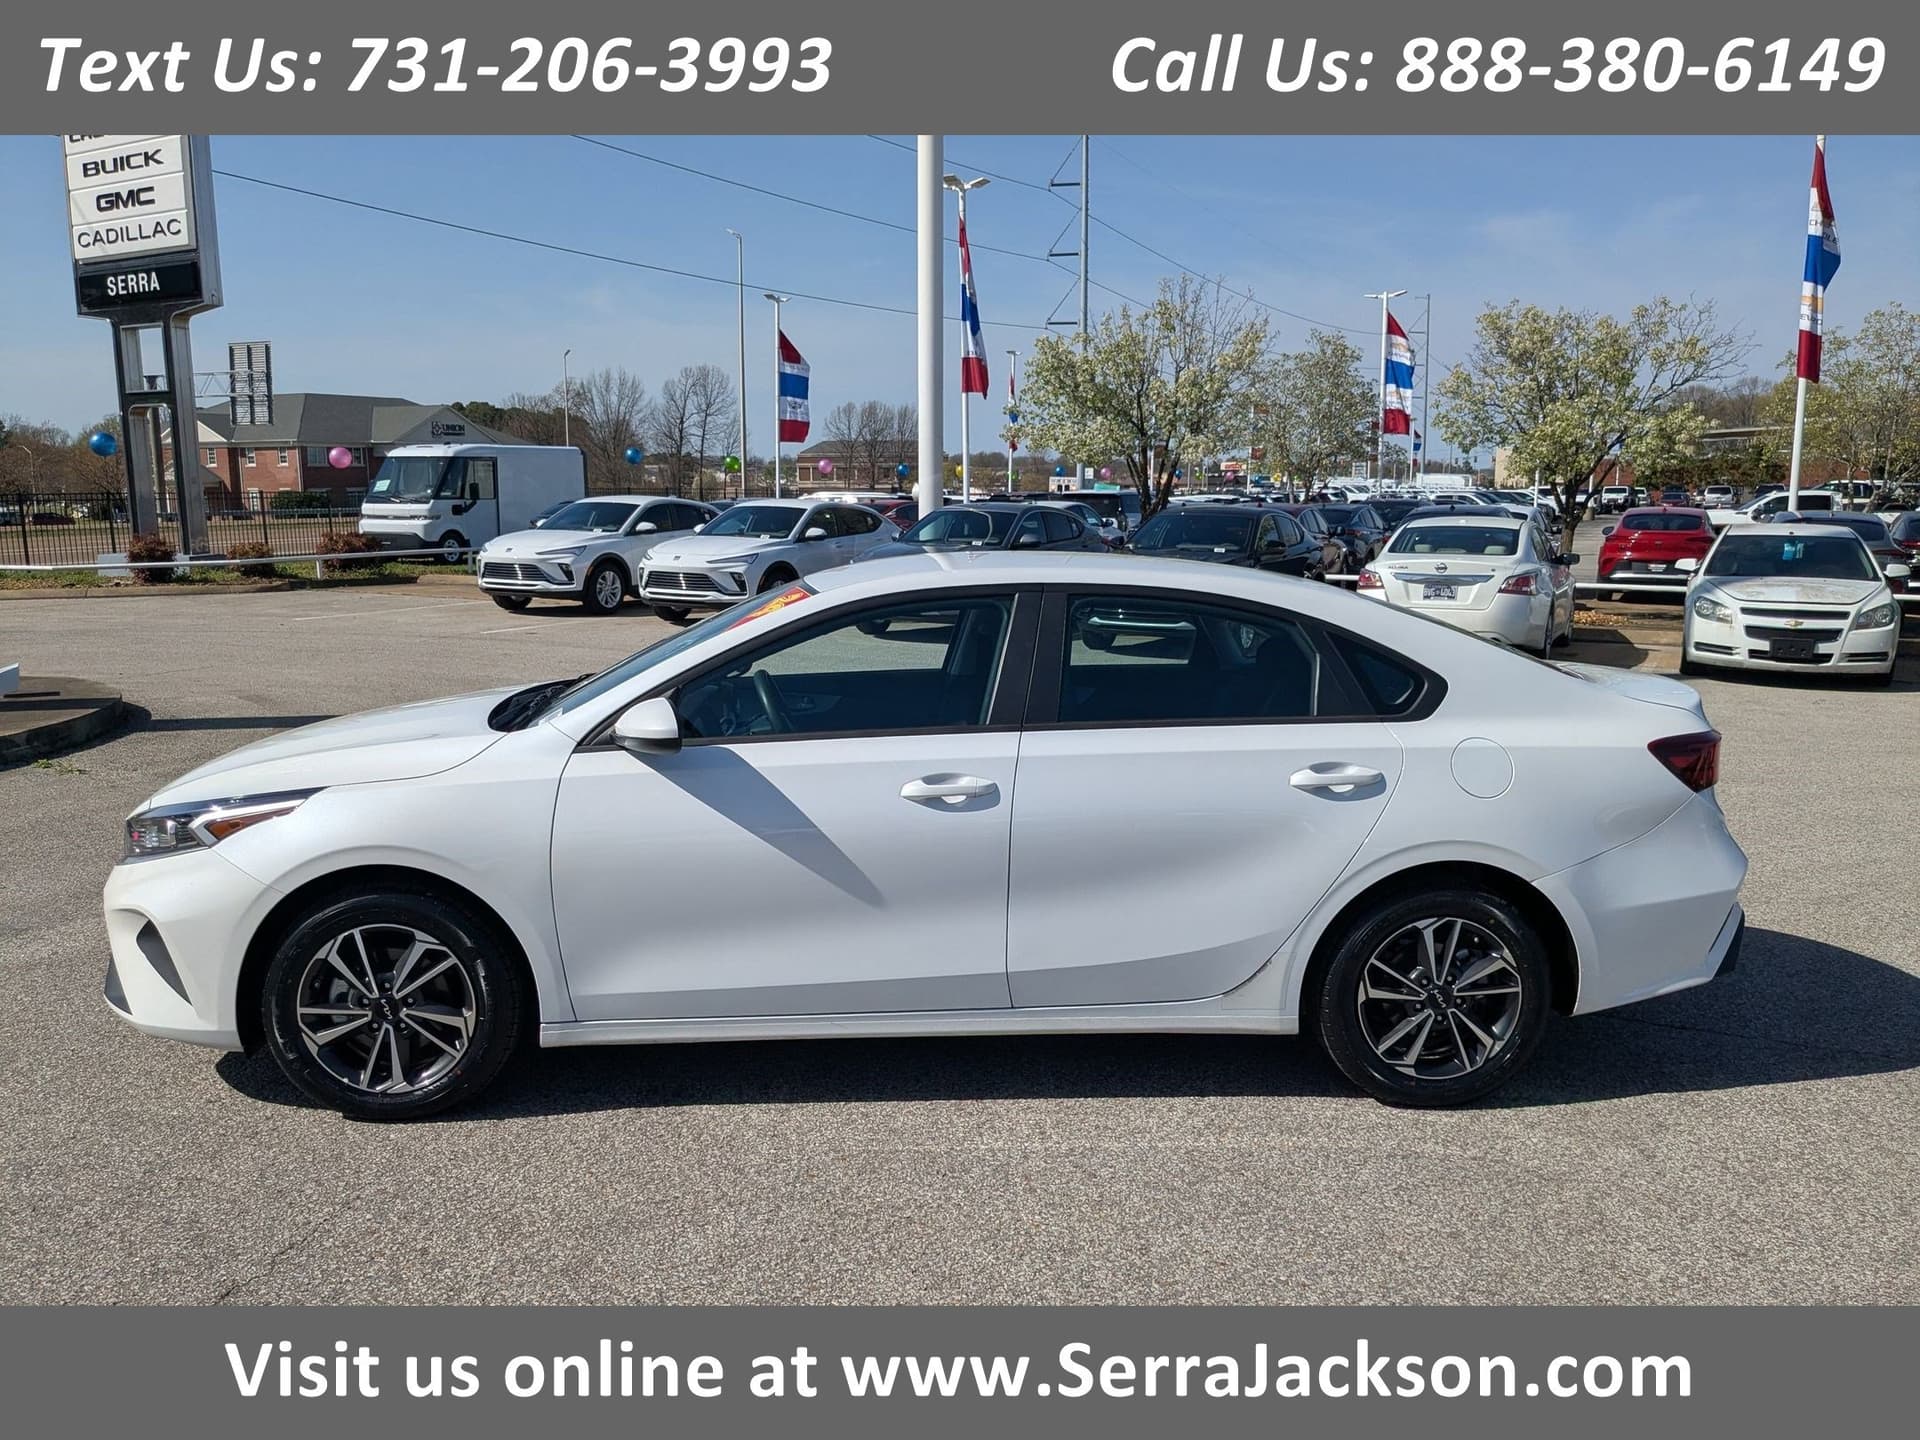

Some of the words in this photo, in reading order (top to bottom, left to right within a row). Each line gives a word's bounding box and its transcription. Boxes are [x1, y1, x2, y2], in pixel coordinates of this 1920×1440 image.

[82, 149, 164, 178] BUICK
[96, 186, 156, 213] GMC
[77, 218, 182, 248] CADILLAC
[107, 271, 161, 297] SERRA
